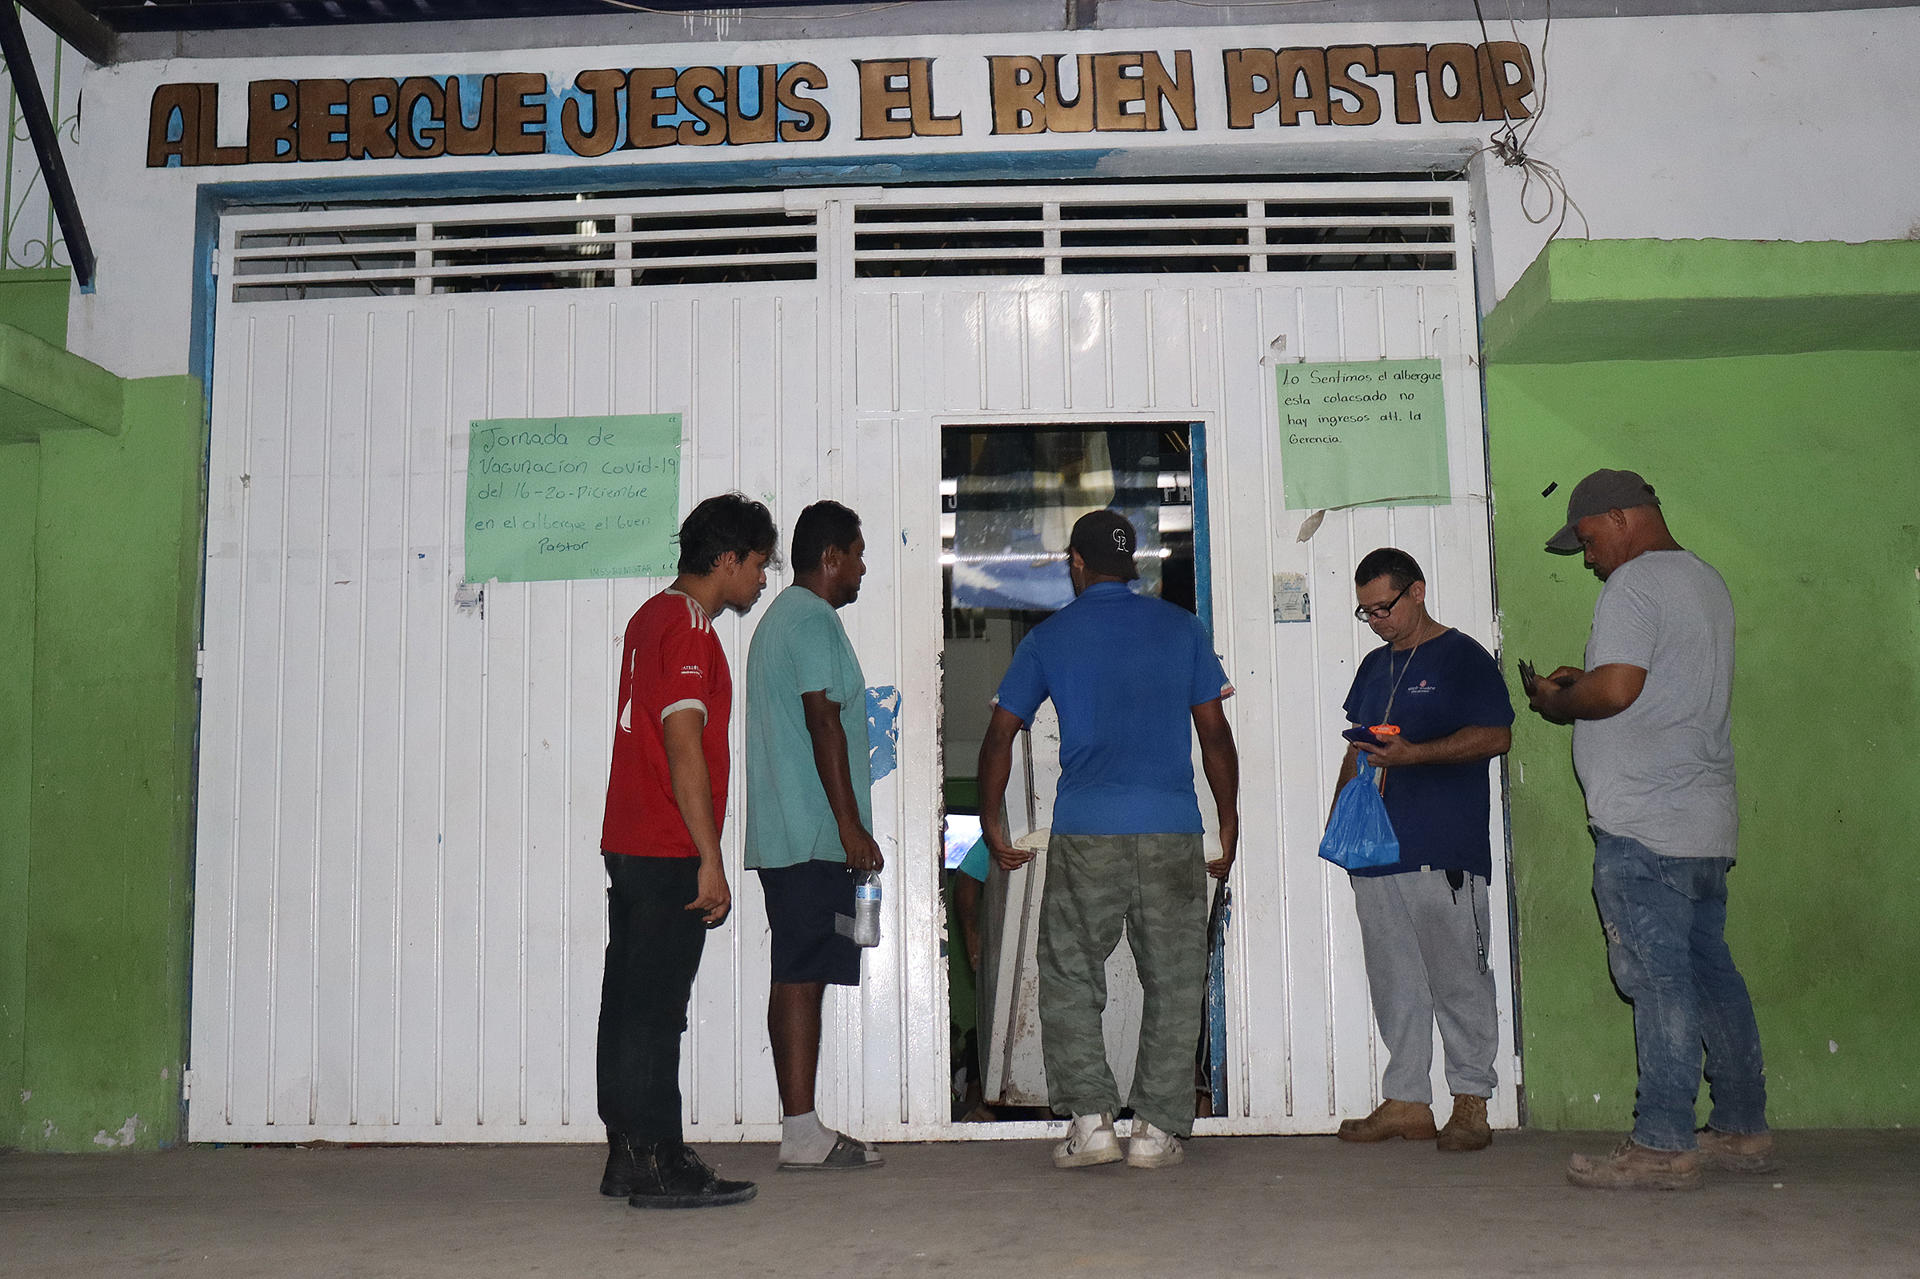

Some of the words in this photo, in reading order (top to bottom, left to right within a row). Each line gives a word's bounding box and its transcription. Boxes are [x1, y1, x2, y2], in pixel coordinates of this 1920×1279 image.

[147, 72, 547, 169] ALBERGUE
[561, 60, 831, 158] JESUS
[851, 56, 963, 141] EL
[984, 48, 1199, 137] BUEN
[1222, 40, 1536, 131] PASTOR
[1377, 371, 1388, 382] el
[1393, 369, 1442, 384] albergue
[1284, 393, 1311, 406] esta
[1399, 391, 1415, 401] no
[1287, 414, 1308, 428] hay
[1317, 413, 1371, 427] ingresos
[1409, 410, 1422, 421] la
[480, 424, 569, 454] Jornada
[587, 426, 617, 447] de
[478, 482, 503, 500] del
[474, 518, 494, 532] en
[503, 515, 517, 530] el
[537, 536, 590, 555] Pastor
